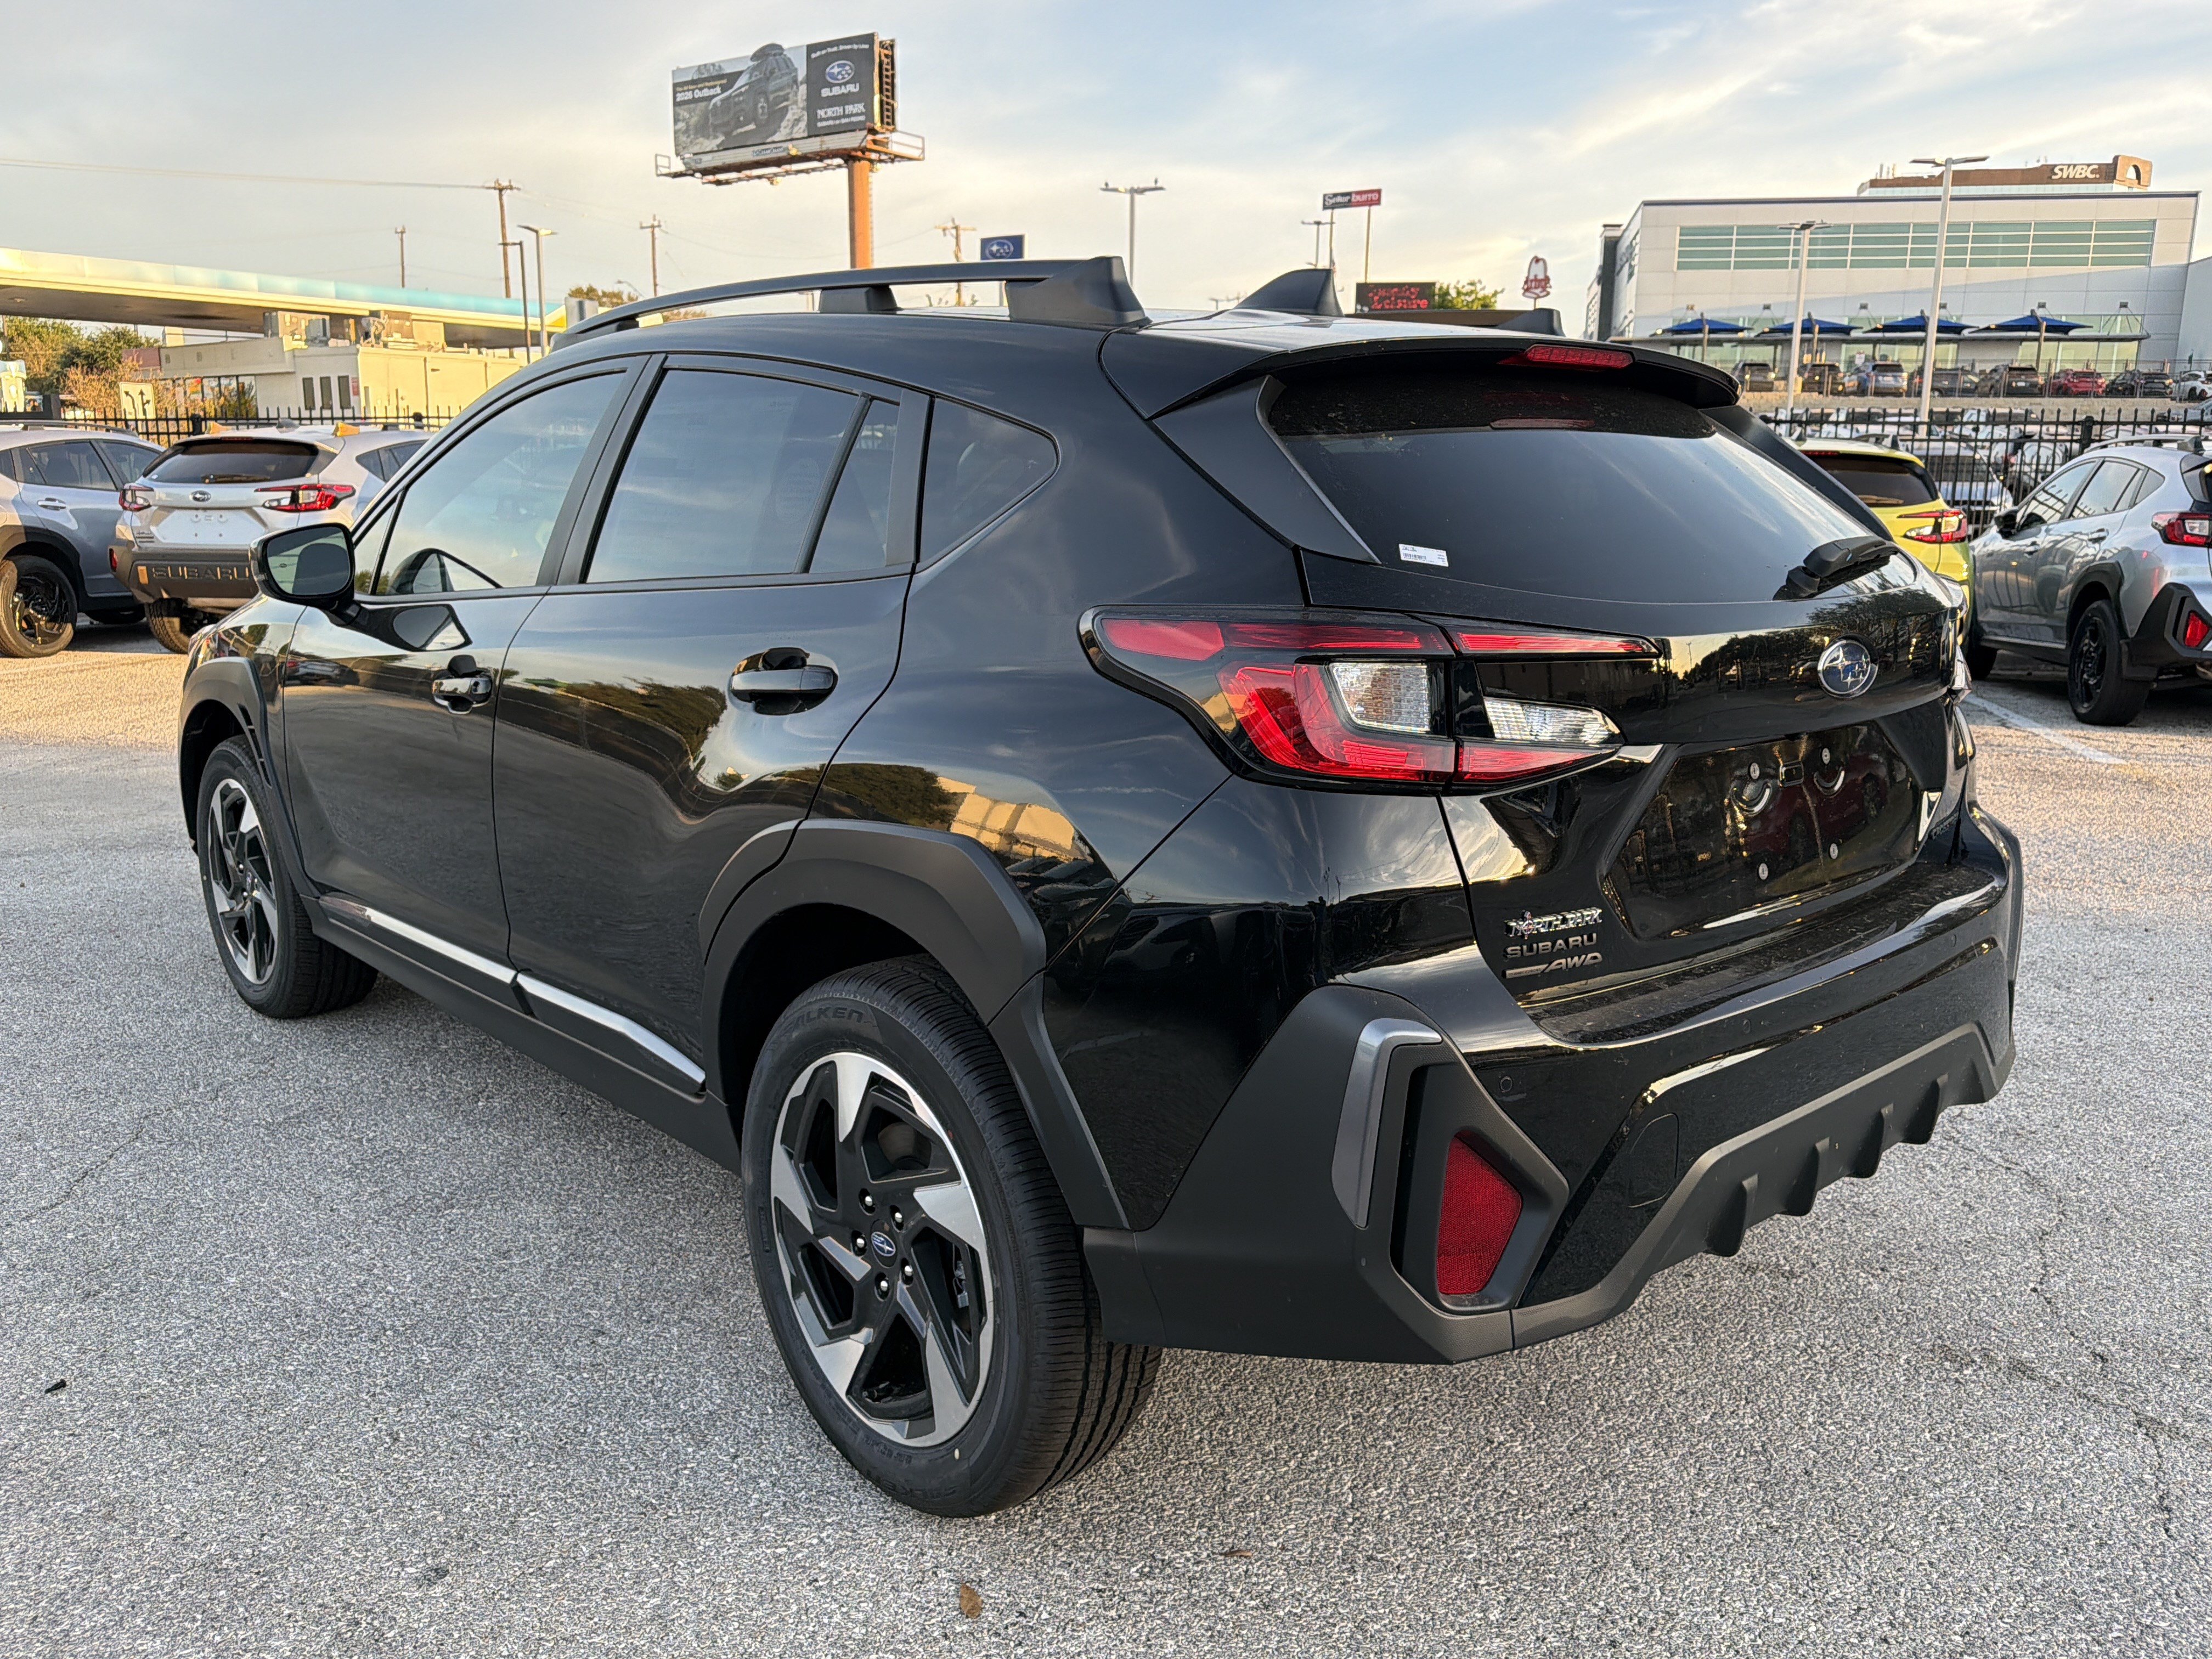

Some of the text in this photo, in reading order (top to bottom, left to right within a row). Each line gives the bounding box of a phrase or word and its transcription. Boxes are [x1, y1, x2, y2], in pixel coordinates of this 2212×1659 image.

[821, 82, 860, 97] SUBARU
[816, 105, 844, 119] NORTH
[151, 566, 250, 580] SUBARU
[1505, 933, 1597, 959] SUBARU
[1544, 952, 1602, 973] AWD
